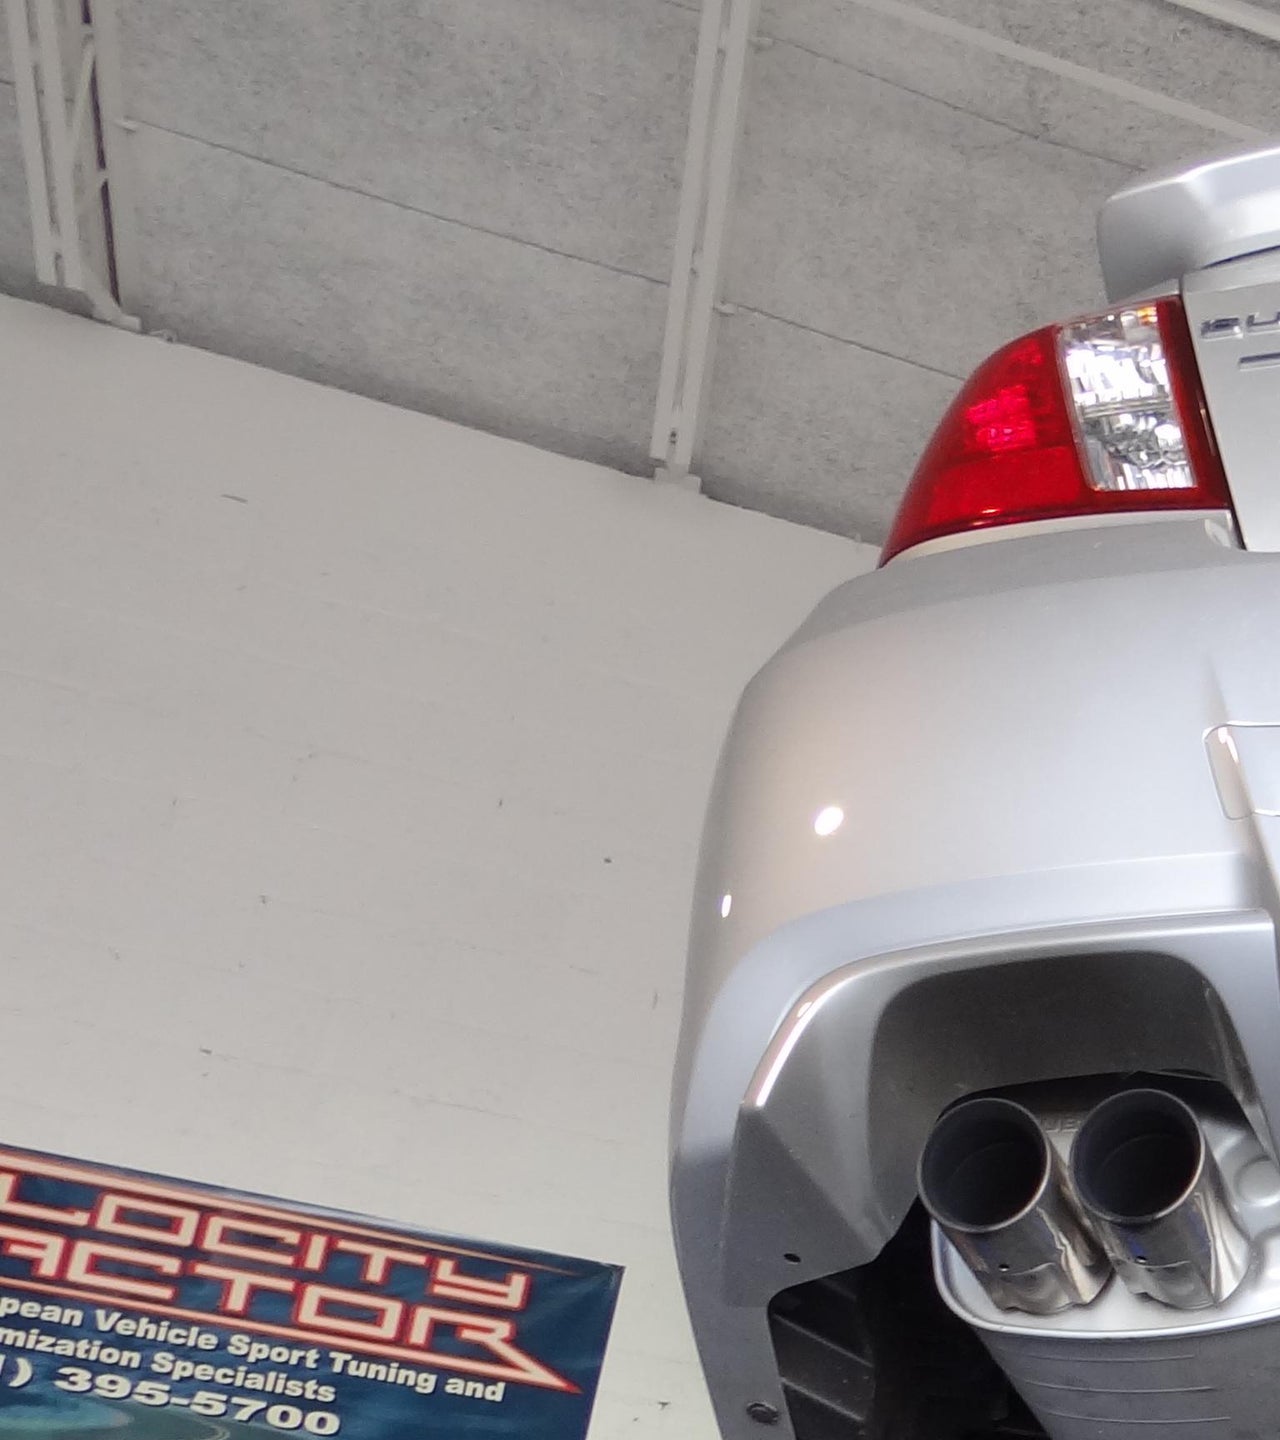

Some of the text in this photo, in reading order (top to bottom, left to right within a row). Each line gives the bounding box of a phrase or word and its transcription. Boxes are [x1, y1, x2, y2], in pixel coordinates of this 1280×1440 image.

[95, 1308, 219, 1351] Vehicle
[227, 1333, 321, 1370] Sport
[329, 1351, 438, 1396] Tuning
[444, 1374, 507, 1402] and
[150, 1351, 337, 1404] Specialists
[53, 1365, 342, 1437] 395-5700
